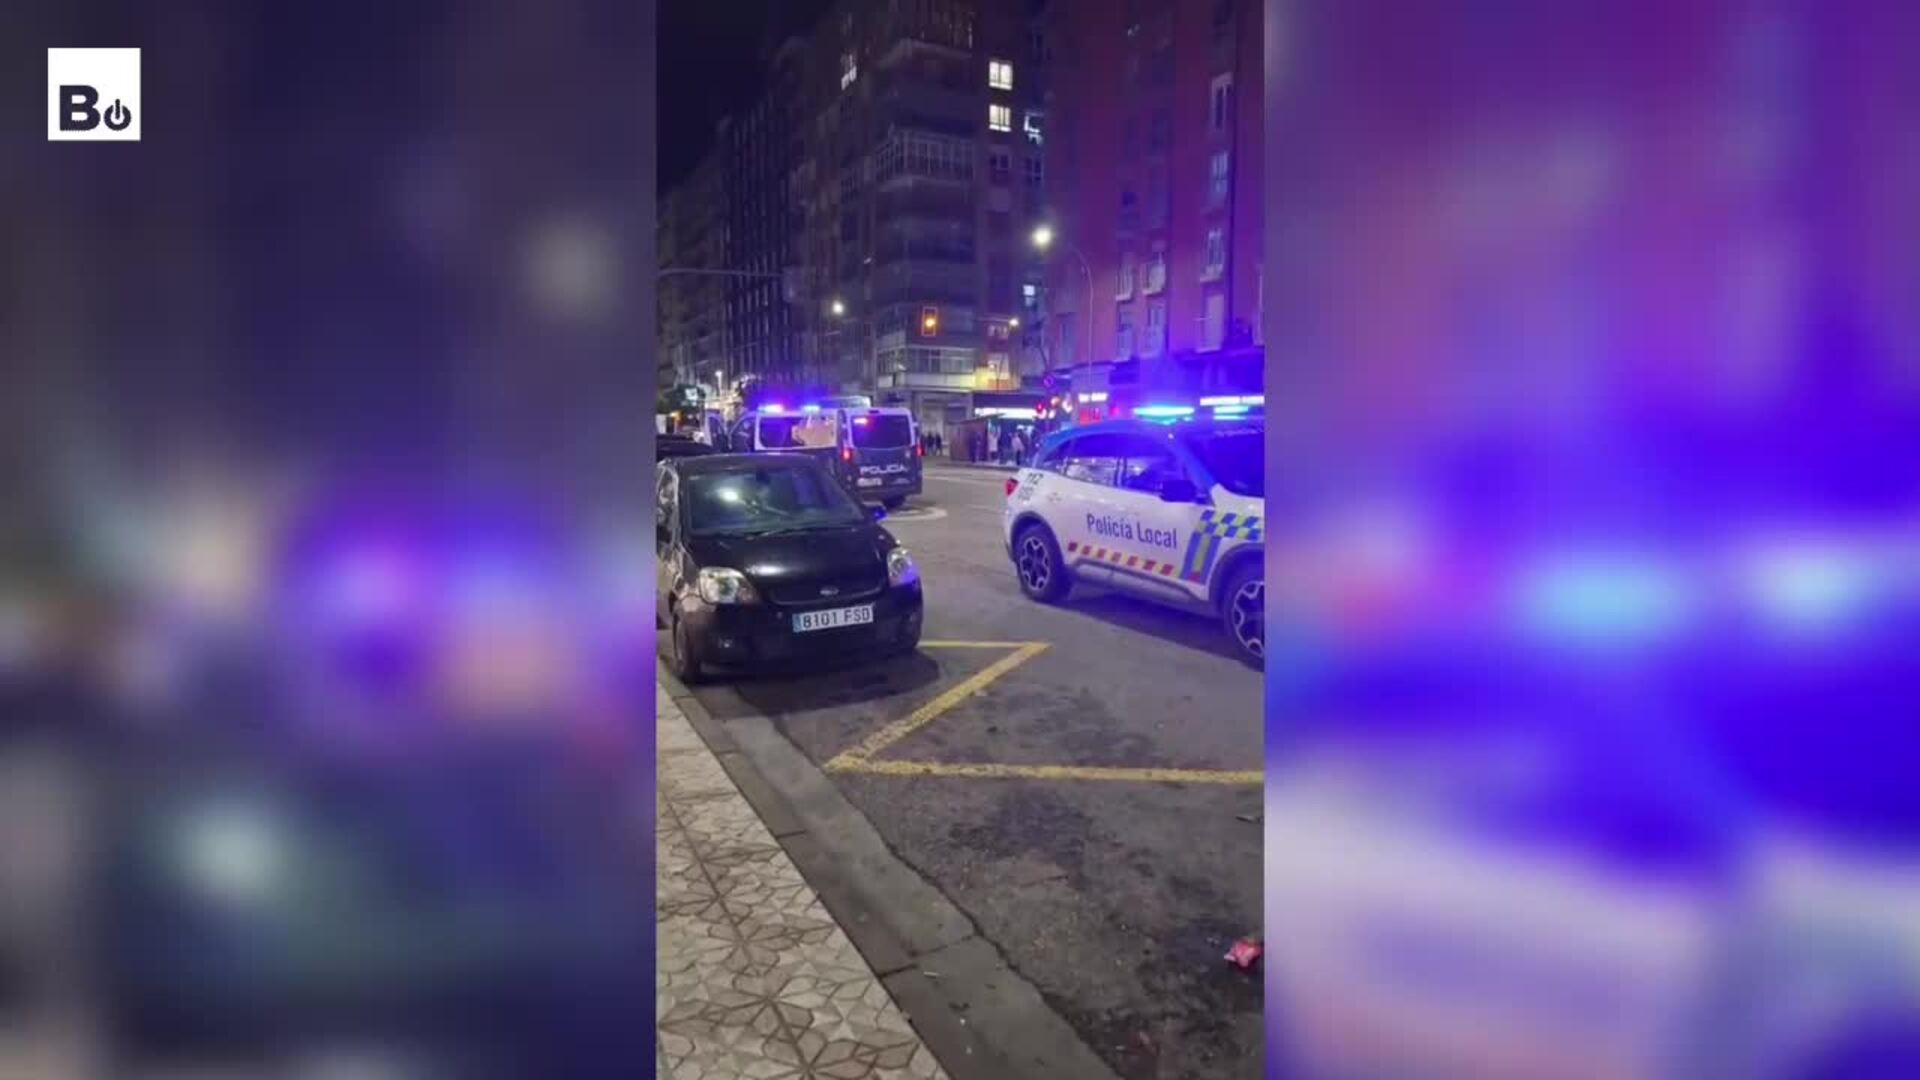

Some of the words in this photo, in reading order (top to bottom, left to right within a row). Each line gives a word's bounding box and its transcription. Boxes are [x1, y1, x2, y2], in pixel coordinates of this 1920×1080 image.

[1086, 513, 1133, 540] Policía
[1137, 522, 1177, 549] Local
[803, 611, 838, 628] 8101
